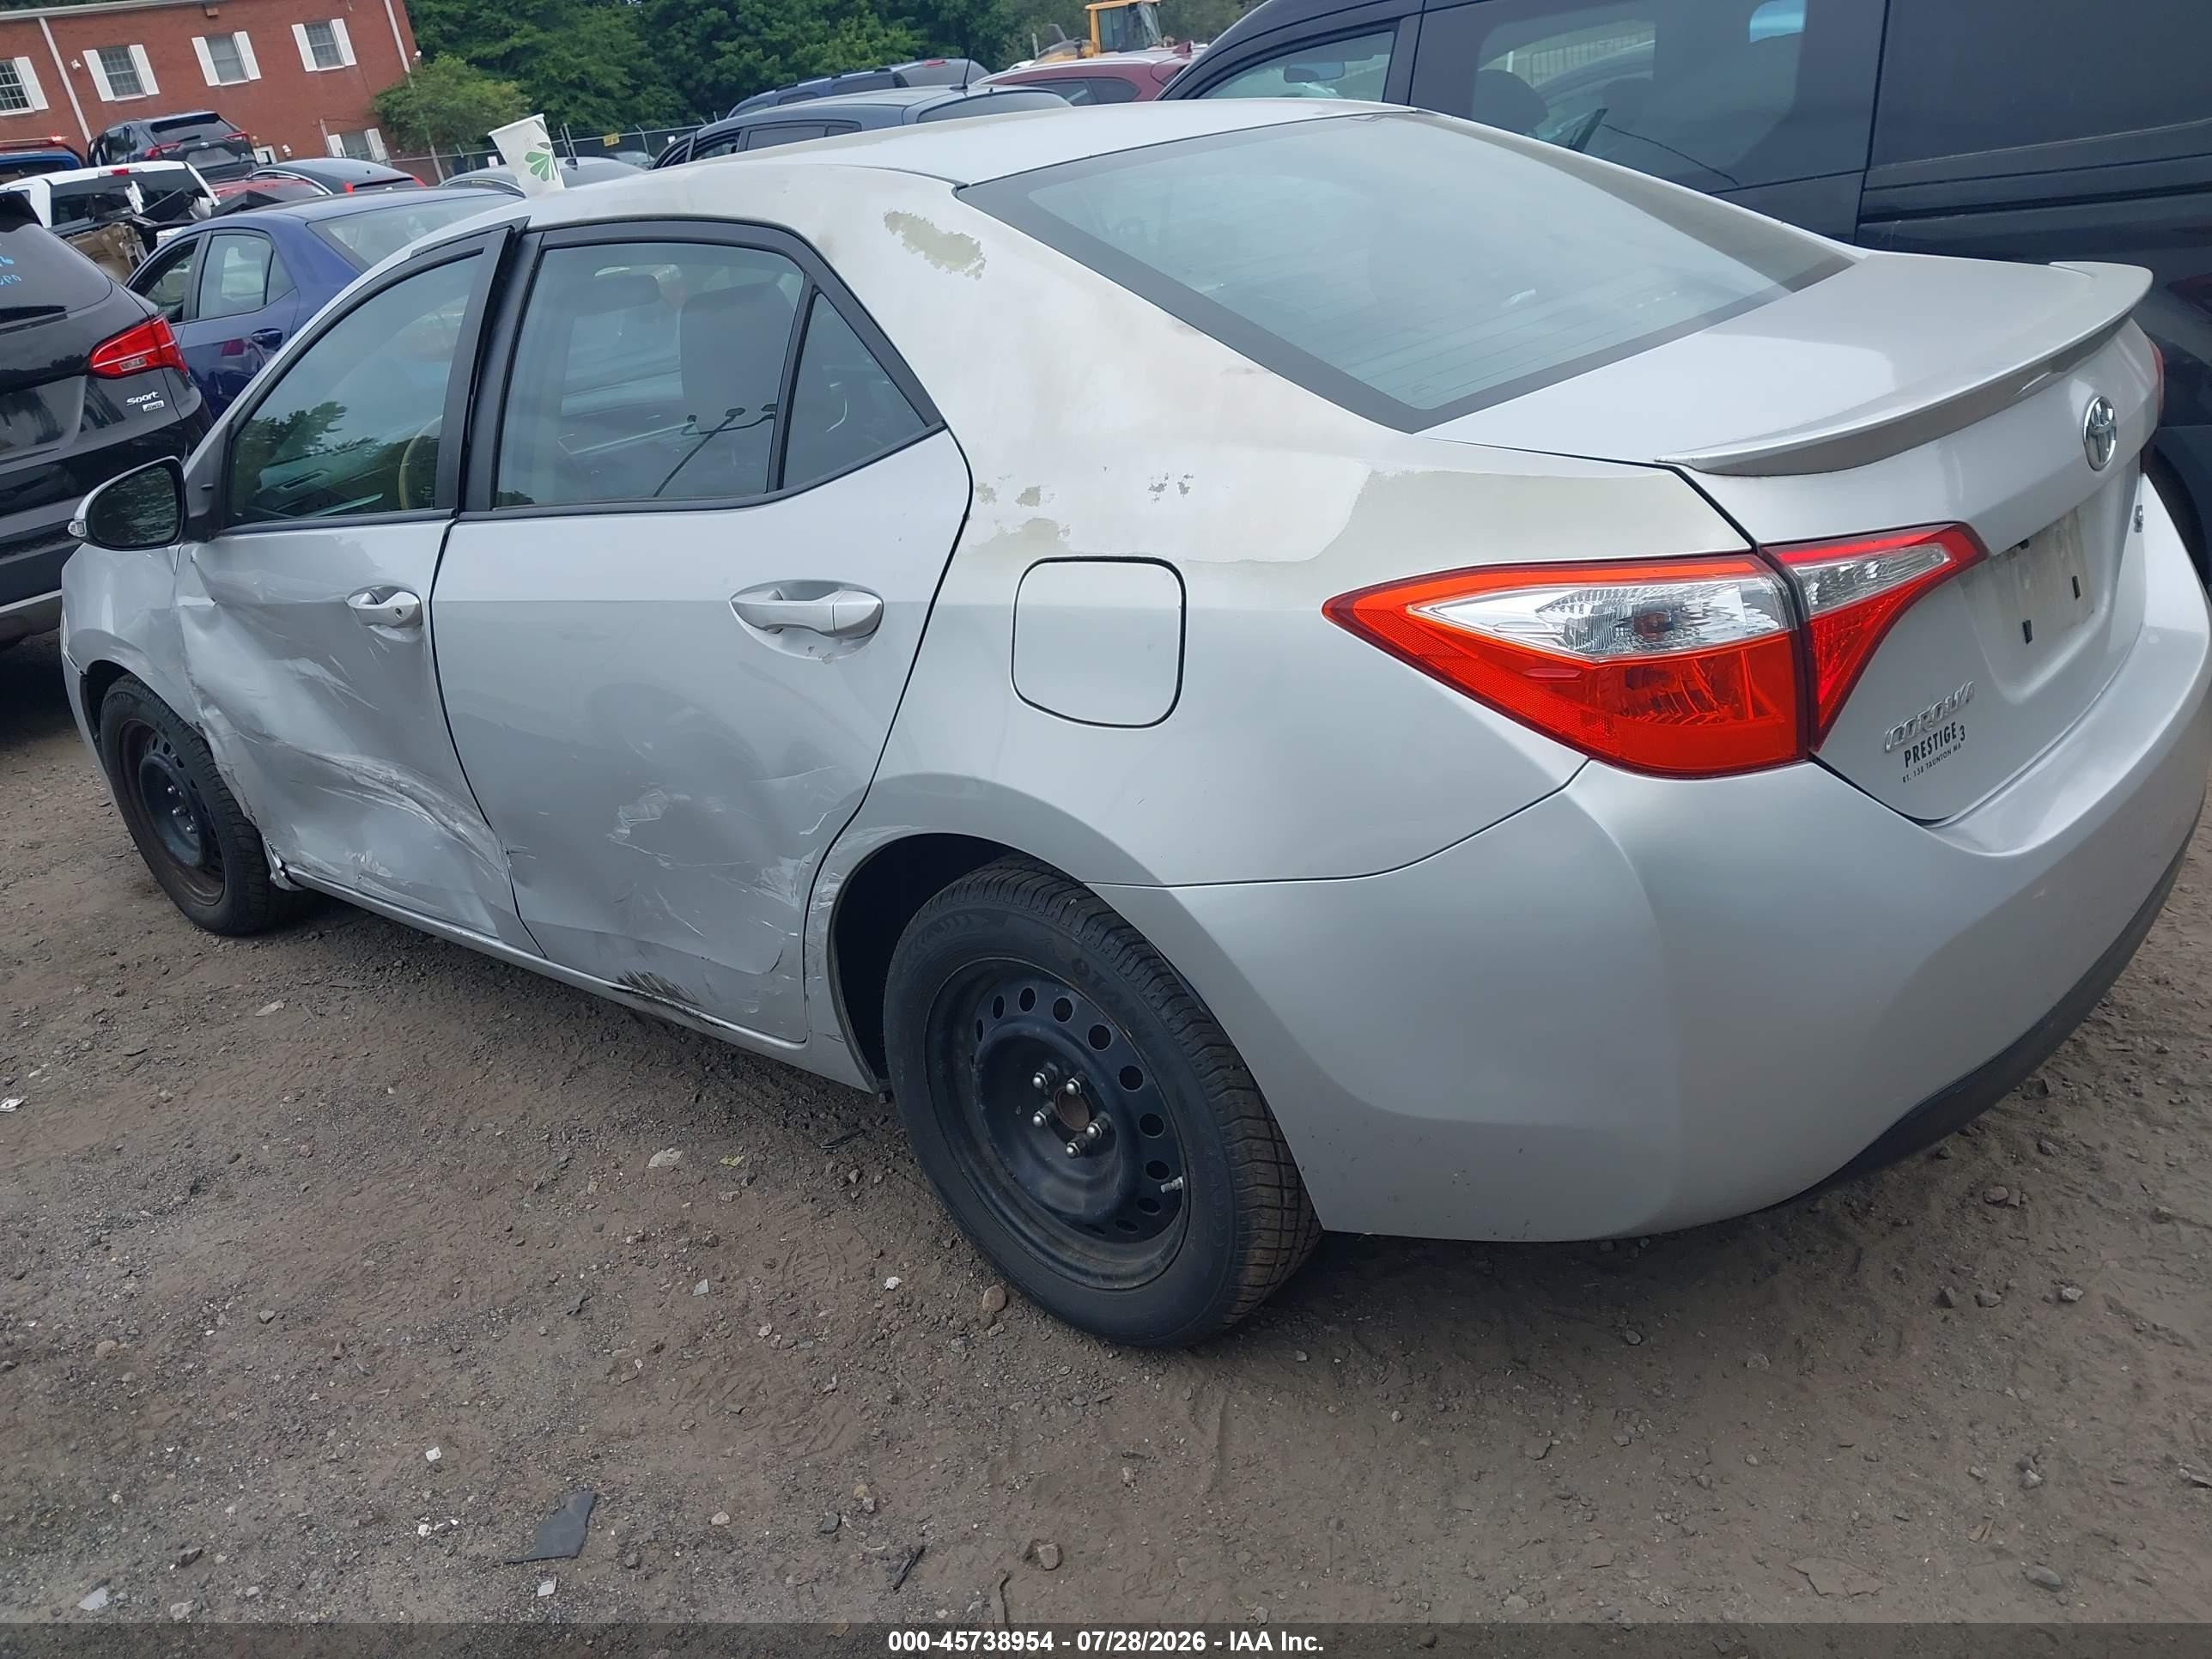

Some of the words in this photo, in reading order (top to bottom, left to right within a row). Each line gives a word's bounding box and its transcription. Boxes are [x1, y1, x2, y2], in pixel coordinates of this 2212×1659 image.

[126, 391, 161, 406] Sport
[1904, 721, 1957, 768] PRESTIGE
[1959, 725, 1966, 742] 3
[1925, 750, 1952, 769] TAUNTON
